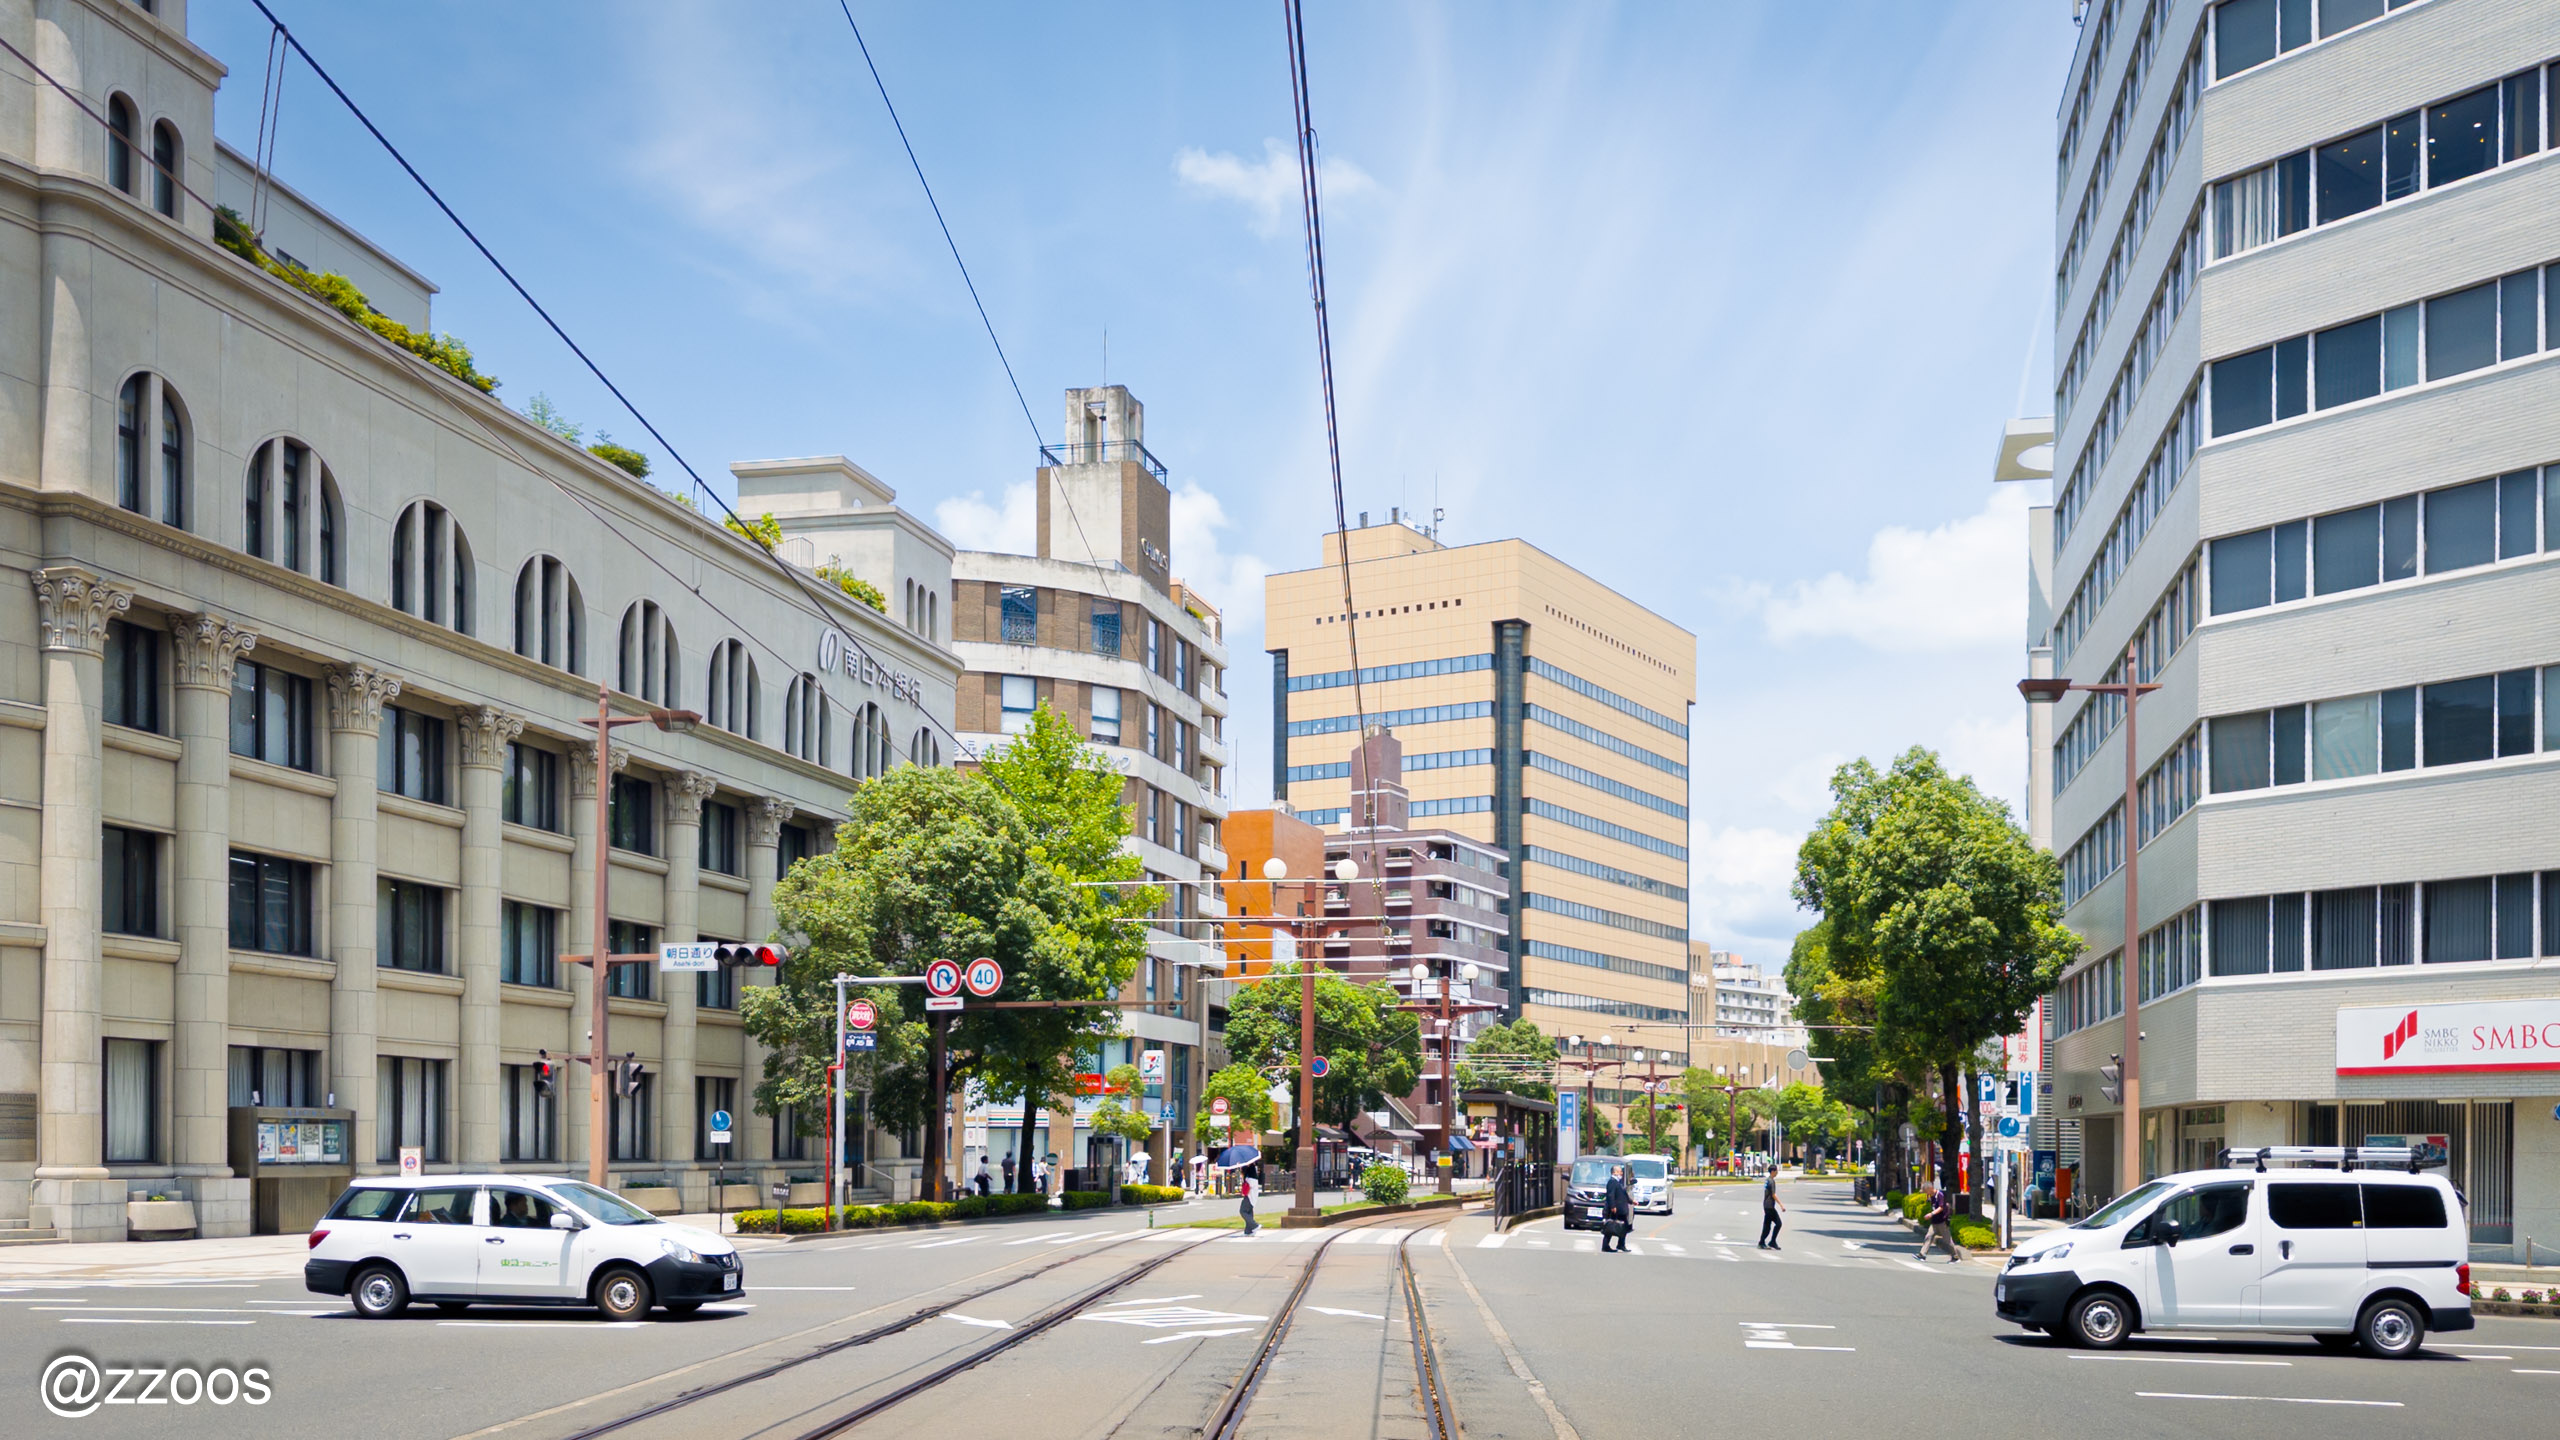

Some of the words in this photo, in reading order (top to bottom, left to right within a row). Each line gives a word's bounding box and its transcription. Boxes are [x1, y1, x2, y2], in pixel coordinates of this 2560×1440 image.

[843, 645, 922, 709] 南日本銀行
[666, 947, 713, 959] 朝日通り
[974, 969, 993, 985] 40
[2424, 1027, 2459, 1039] SMBC
[2472, 1022, 2560, 1051] SMBC
[2424, 1038, 2459, 1048] NIKKO
[1980, 1076, 1995, 1100] P
